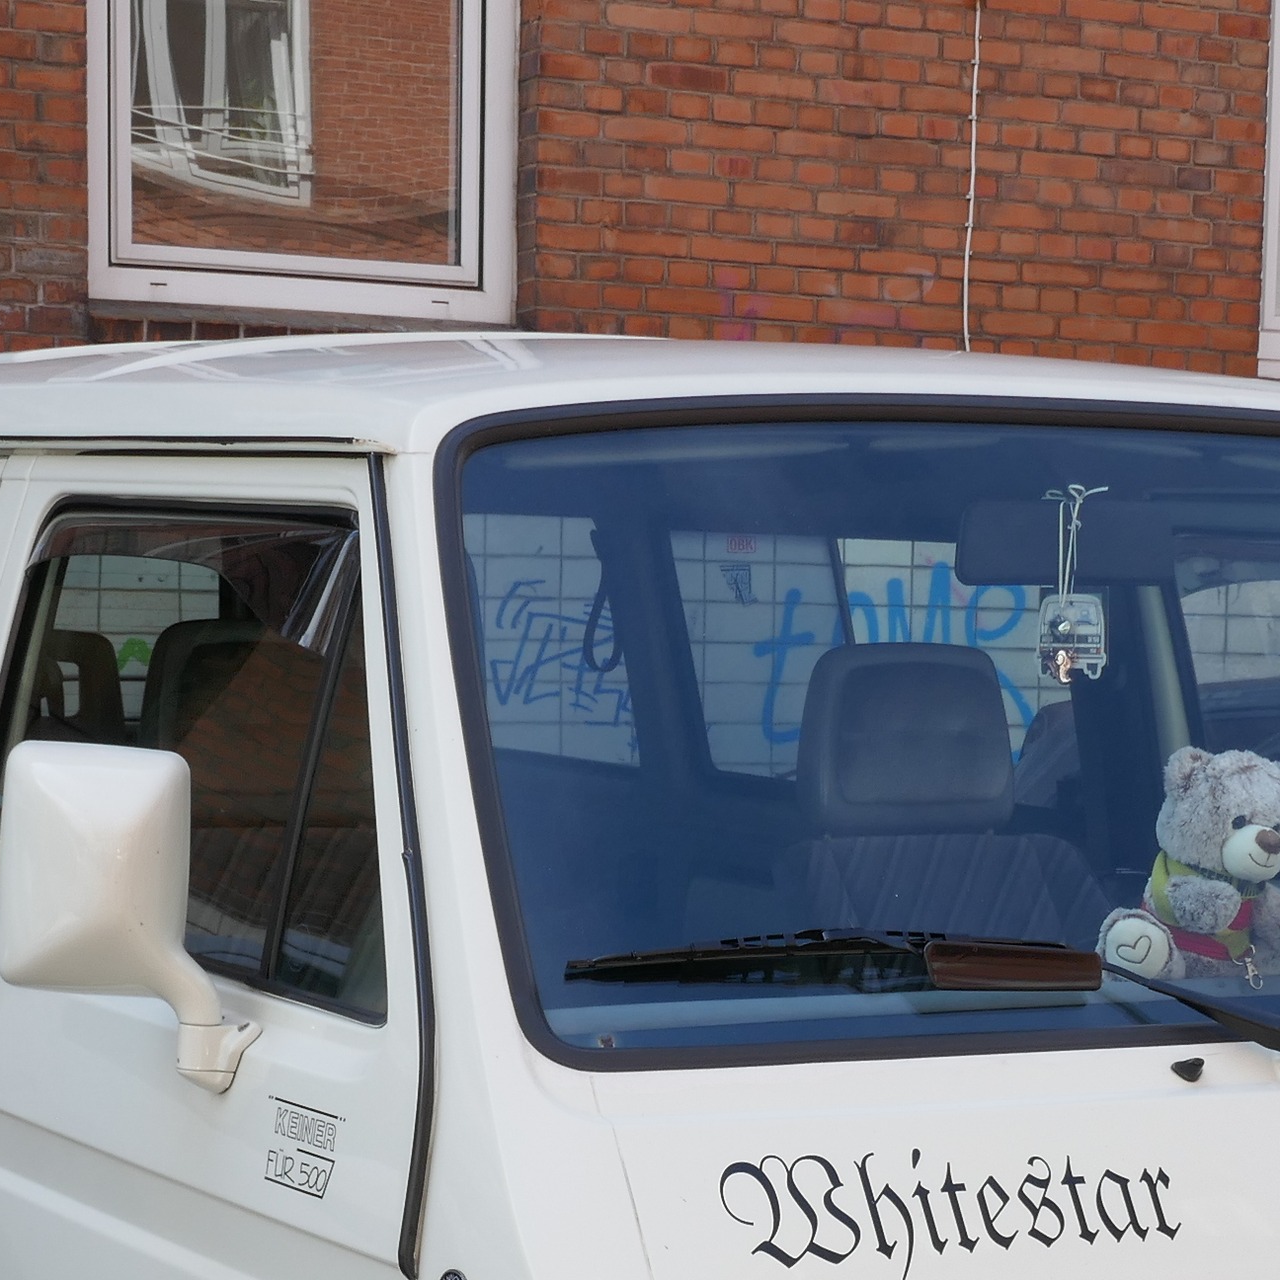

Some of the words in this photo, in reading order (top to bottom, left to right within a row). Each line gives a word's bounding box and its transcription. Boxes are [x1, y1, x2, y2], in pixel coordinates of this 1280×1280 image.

[274, 1107, 337, 1152] KEINER
[265, 1148, 295, 1184] FÜR
[298, 1162, 327, 1192] 500
